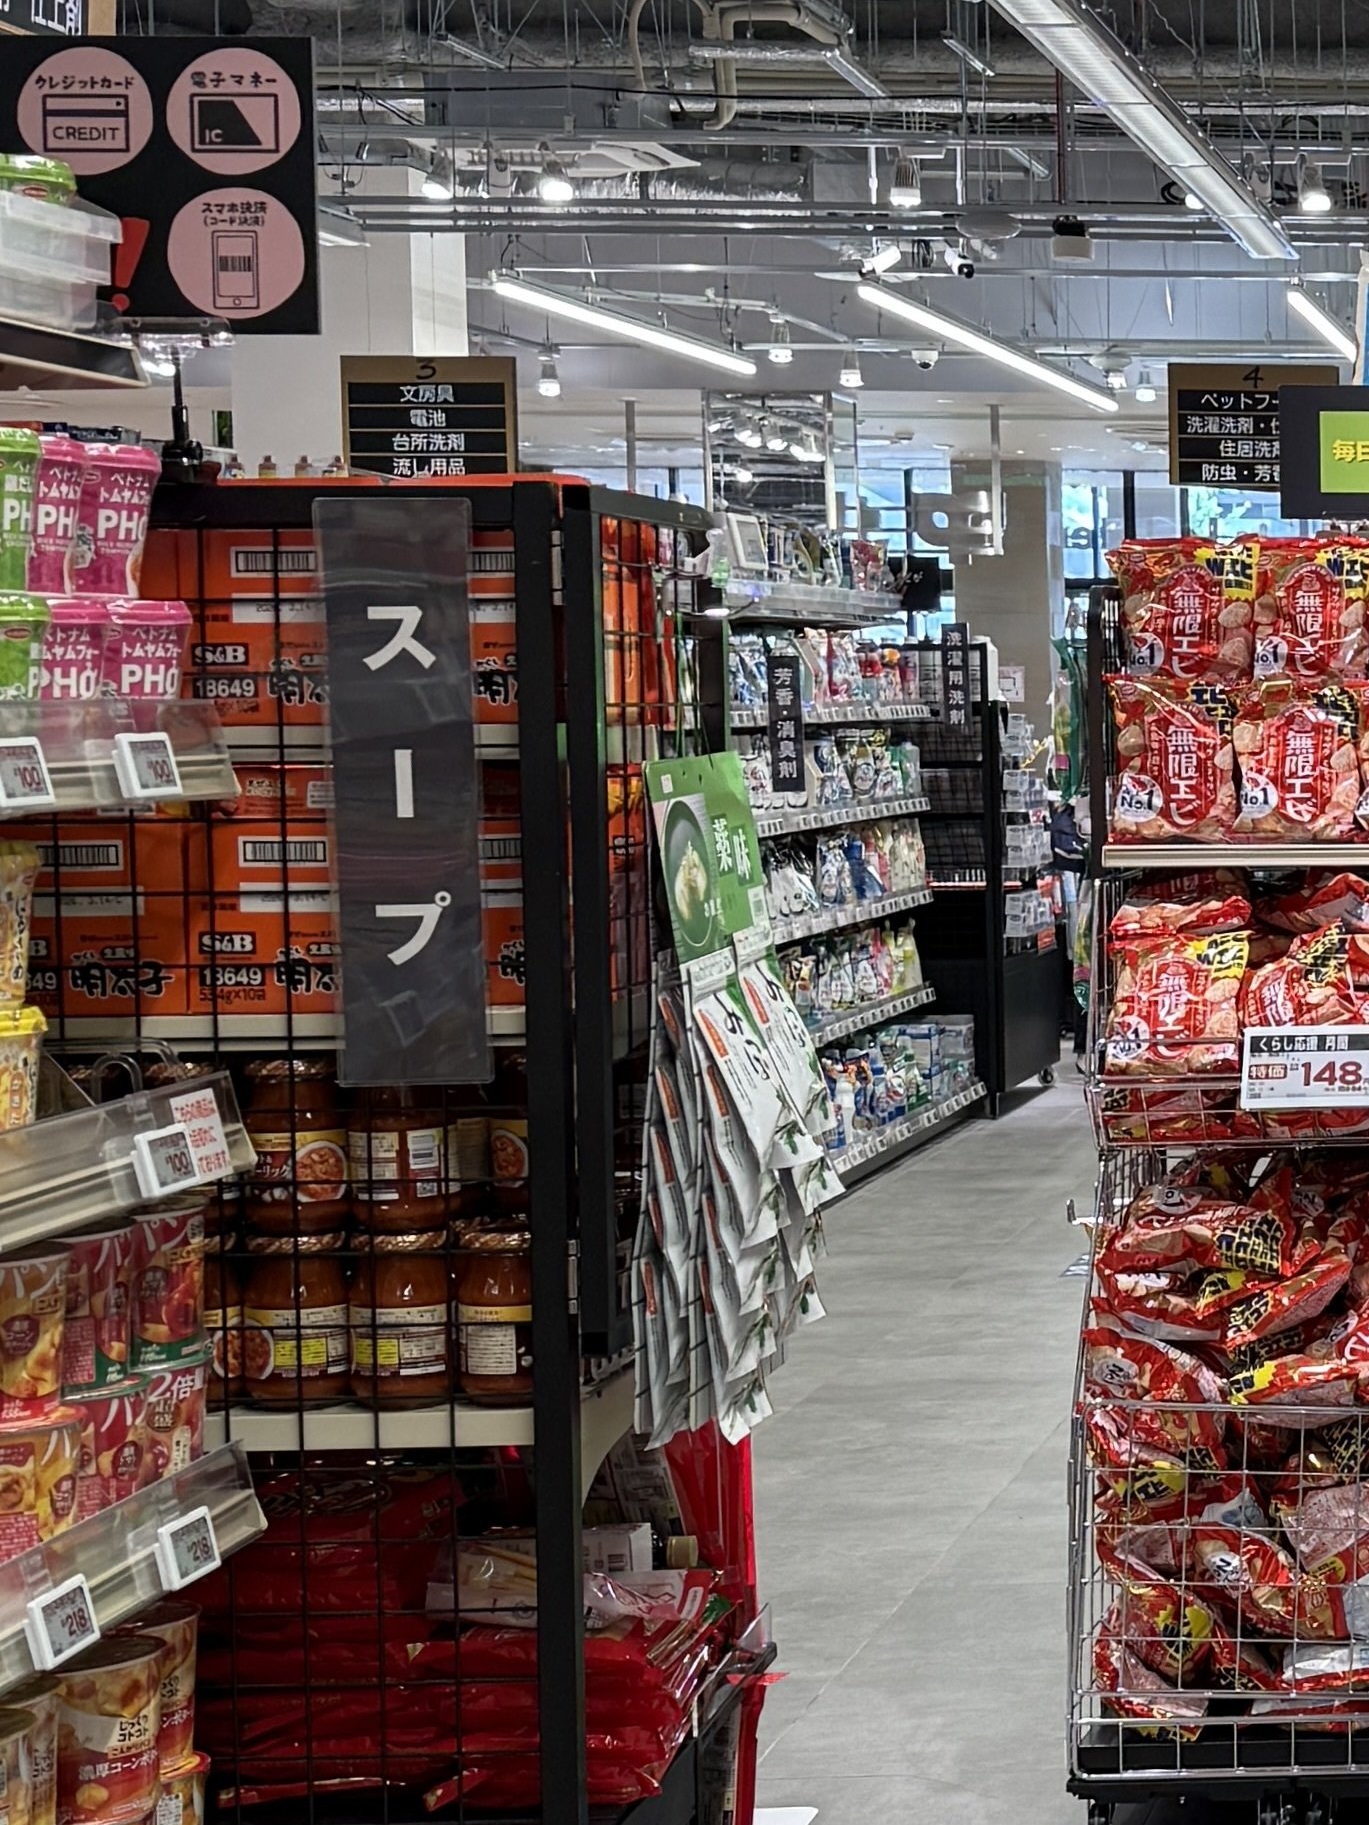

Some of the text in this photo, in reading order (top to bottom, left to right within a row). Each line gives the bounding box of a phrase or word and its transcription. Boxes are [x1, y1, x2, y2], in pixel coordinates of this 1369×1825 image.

[35, 75, 135, 90] クレジットカード
[190, 71, 278, 89] 電子マネー
[52, 127, 120, 141] CREDIT
[205, 129, 223, 143] IC
[416, 358, 437, 380] 3
[1243, 366, 1264, 388] 4
[400, 385, 454, 403] 文房具
[409, 409, 447, 428] 電池
[392, 433, 465, 452] 台所洗剤
[393, 458, 466, 475] 流し用品
[132, 628, 178, 641] ベトナム
[1172, 589, 1204, 675] 無限エビ
[121, 642, 182, 658] トムヤムフォー
[194, 646, 247, 663] S&B
[196, 679, 256, 698] 18649
[773, 666, 798, 780] 芳香・消臭剤
[1168, 726, 1200, 826] 無限エビ
[1284, 726, 1318, 823] 無限エビ
[363, 605, 451, 966] スープ
[1121, 789, 1155, 812] No.1
[201, 935, 254, 952] S&B
[201, 967, 263, 987] 18649
[1150, 972, 1191, 1063] 無限エビ
[1301, 1062, 1363, 1087] 148
[117, 1730, 151, 1745] コトコト
